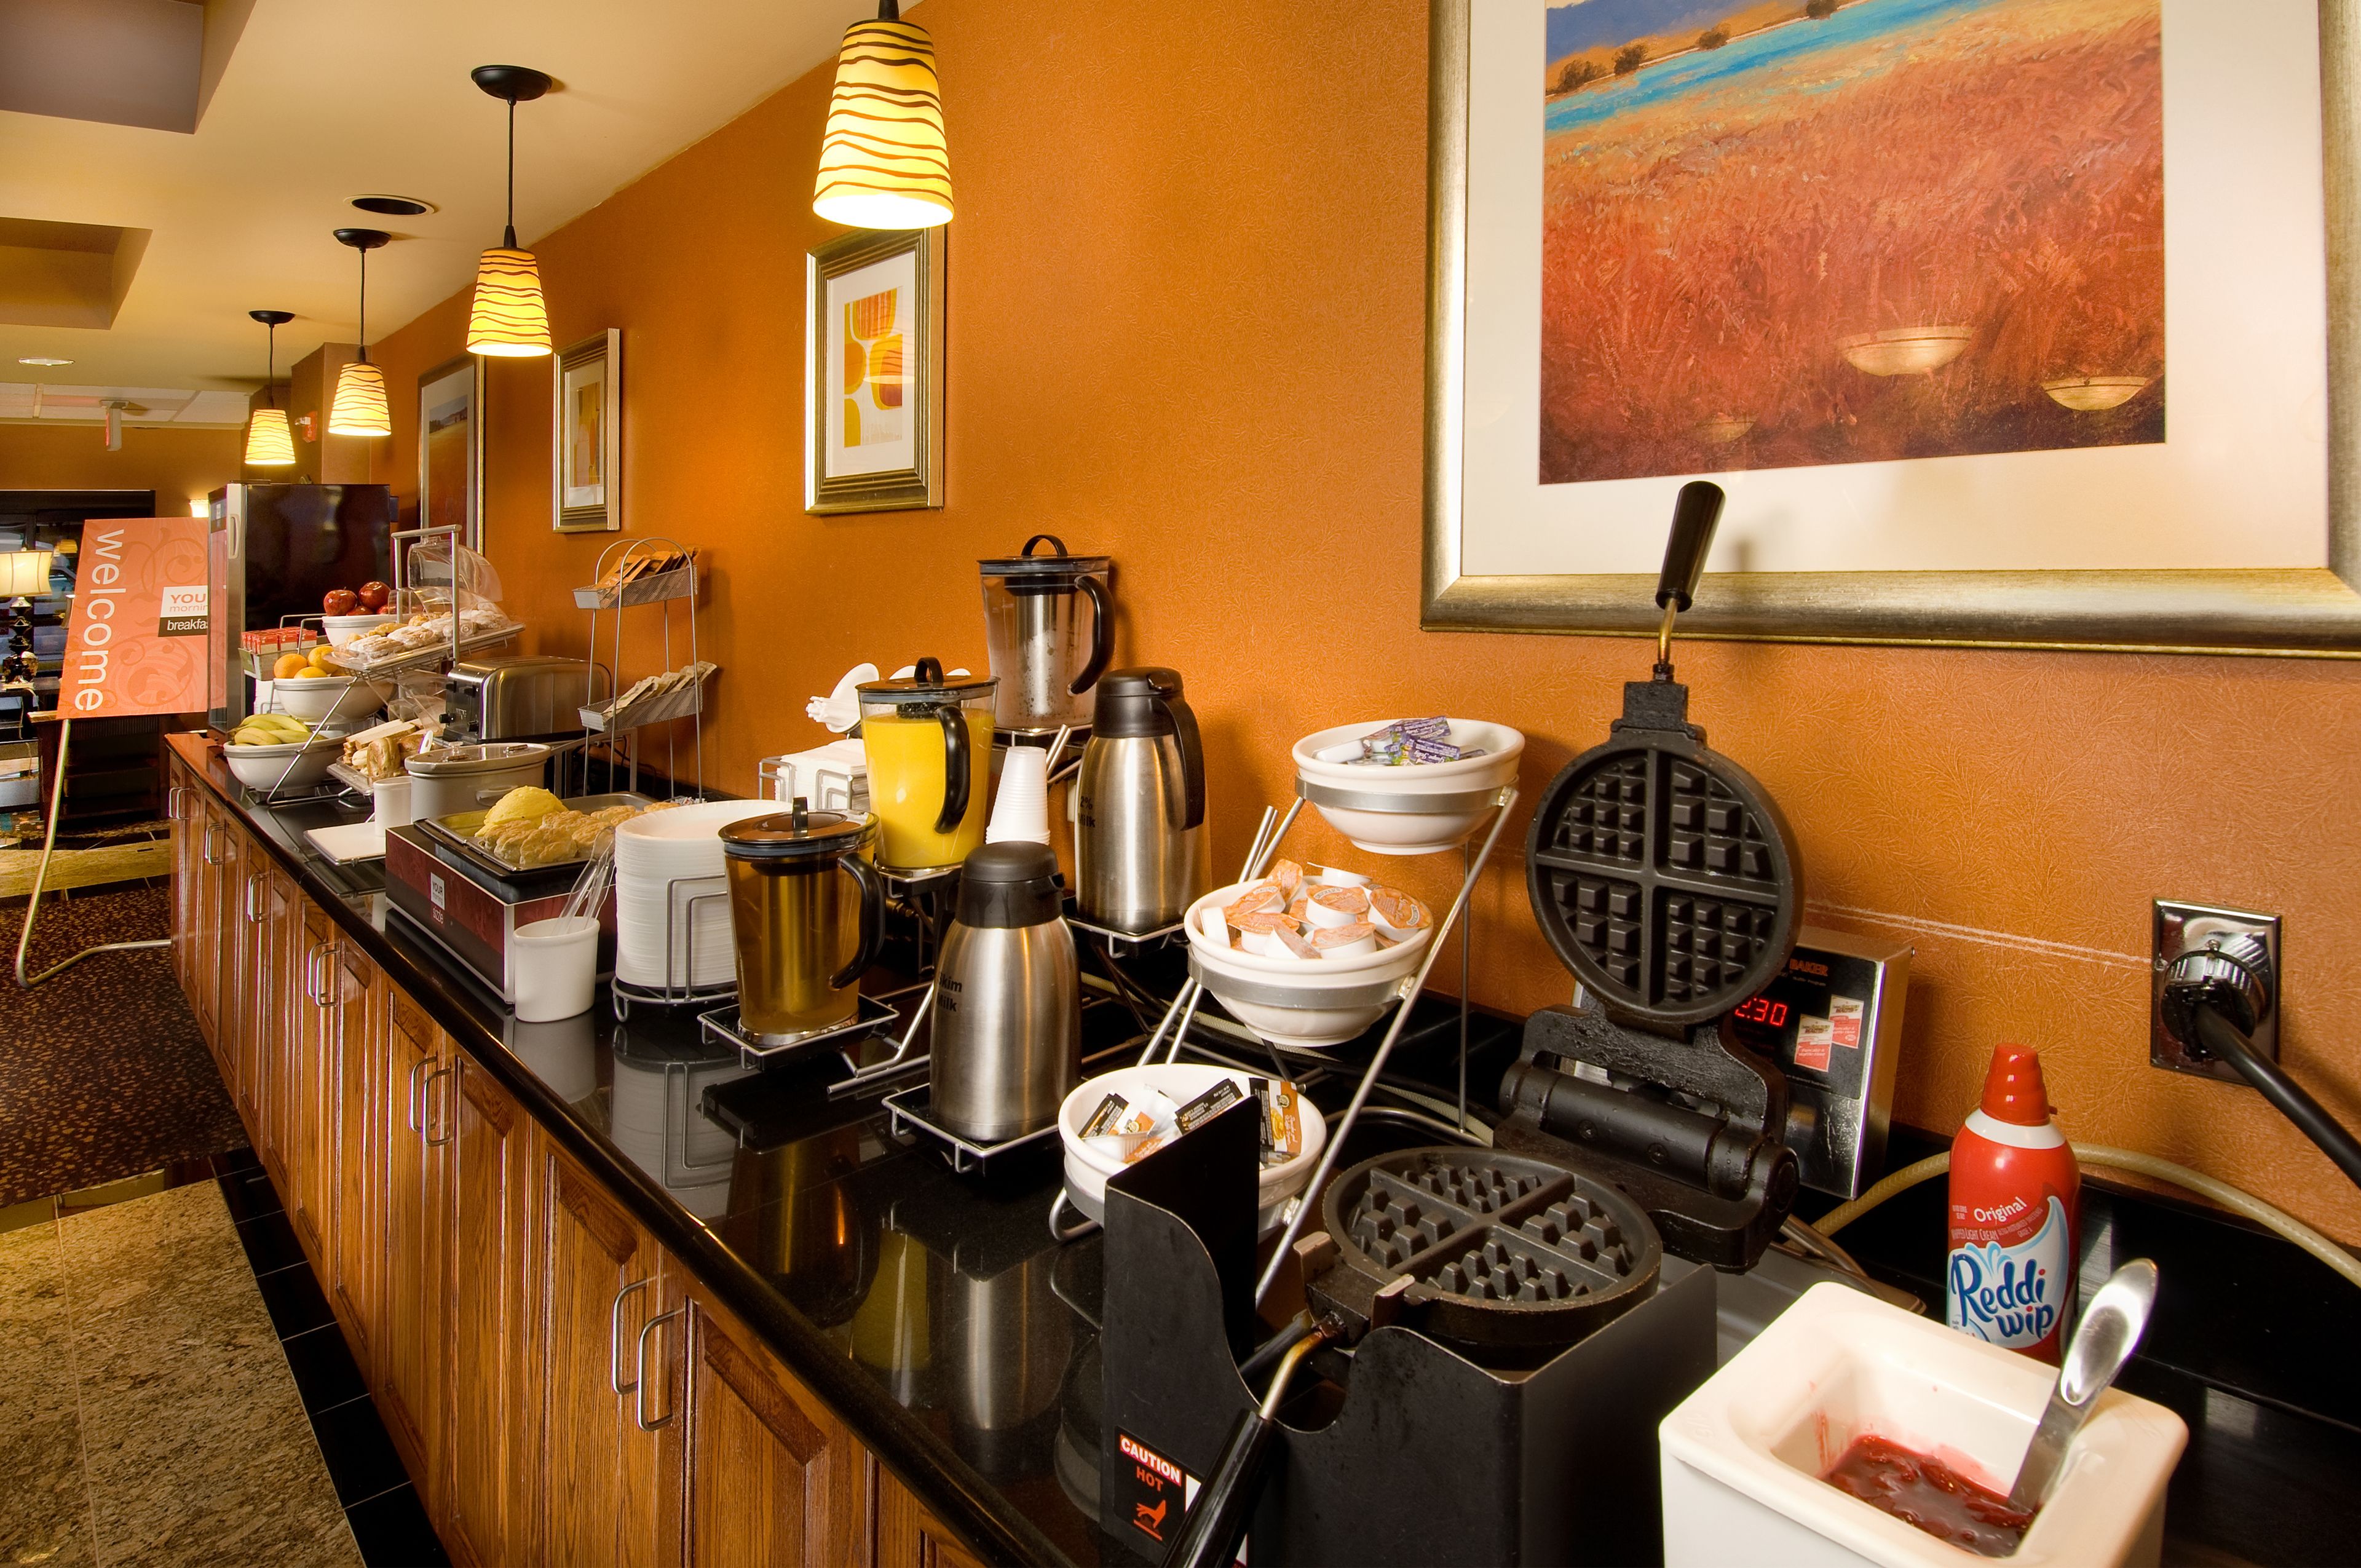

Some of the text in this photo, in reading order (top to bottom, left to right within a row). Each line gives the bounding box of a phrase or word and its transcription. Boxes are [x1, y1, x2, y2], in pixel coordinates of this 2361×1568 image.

[170, 593, 206, 604] YOU
[74, 529, 127, 711] welcome
[1789, 958, 1829, 977] BAKER
[1974, 1196, 2027, 1222] Original
[1964, 1228, 1979, 1240] LIGHT
[1979, 1229, 1999, 1241] CREAM
[1950, 1253, 2046, 1328] Reddi
[1995, 1304, 2055, 1340] wip
[1120, 1437, 1181, 1484] CAUTION
[1136, 1466, 1164, 1492] HOT
